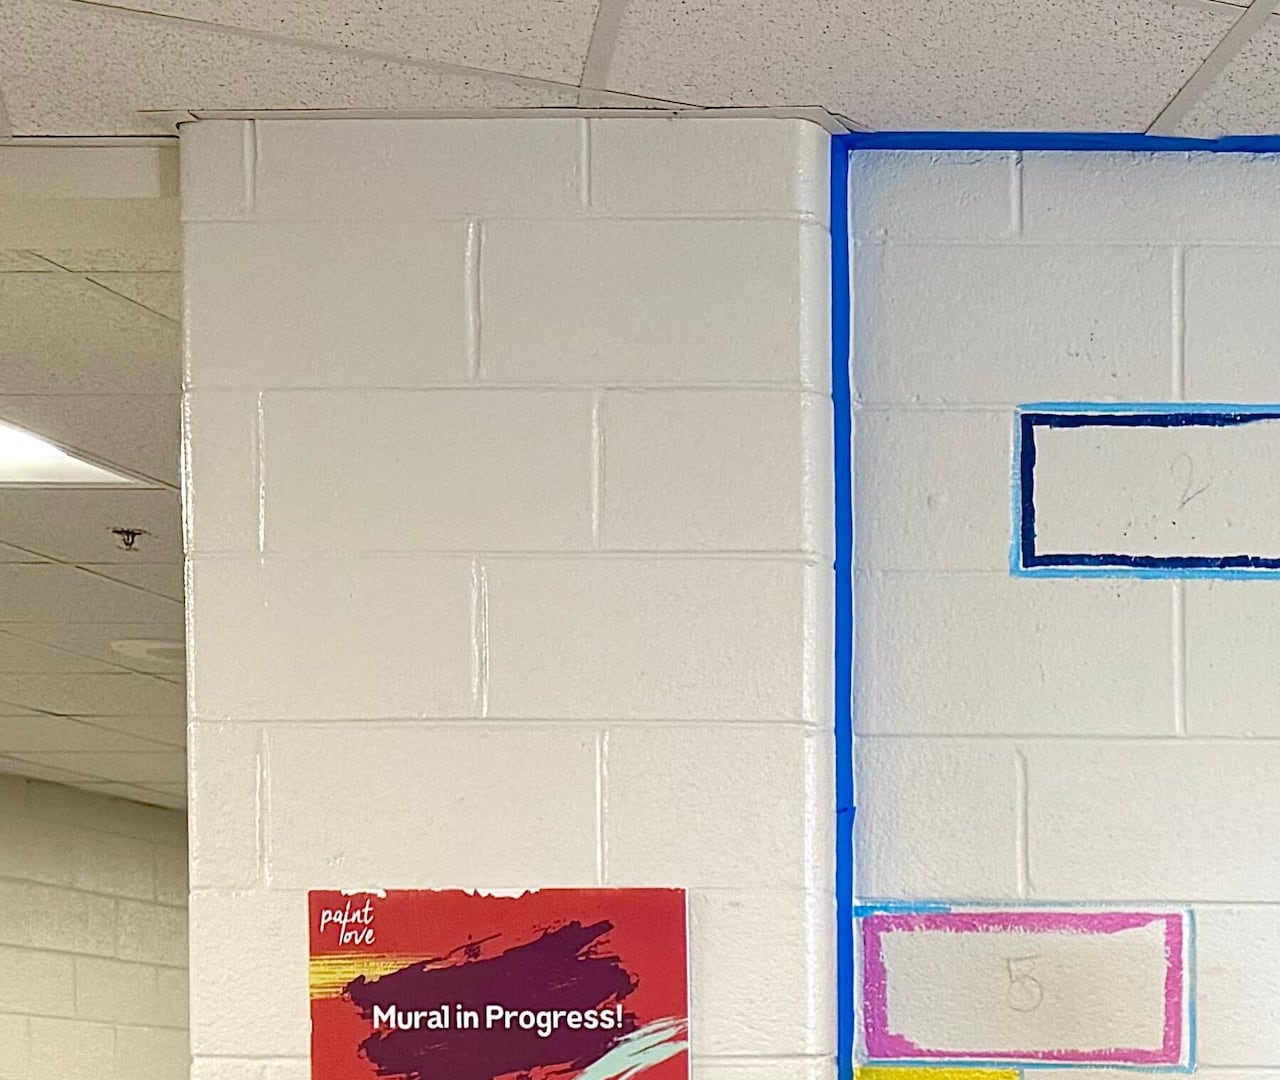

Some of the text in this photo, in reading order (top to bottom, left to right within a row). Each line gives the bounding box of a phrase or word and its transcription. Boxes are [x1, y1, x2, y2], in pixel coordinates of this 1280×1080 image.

[320, 898, 374, 933] paint
[339, 923, 376, 946] love
[1007, 954, 1044, 1013] 5
[373, 1004, 623, 1038] Mural in Progress!
